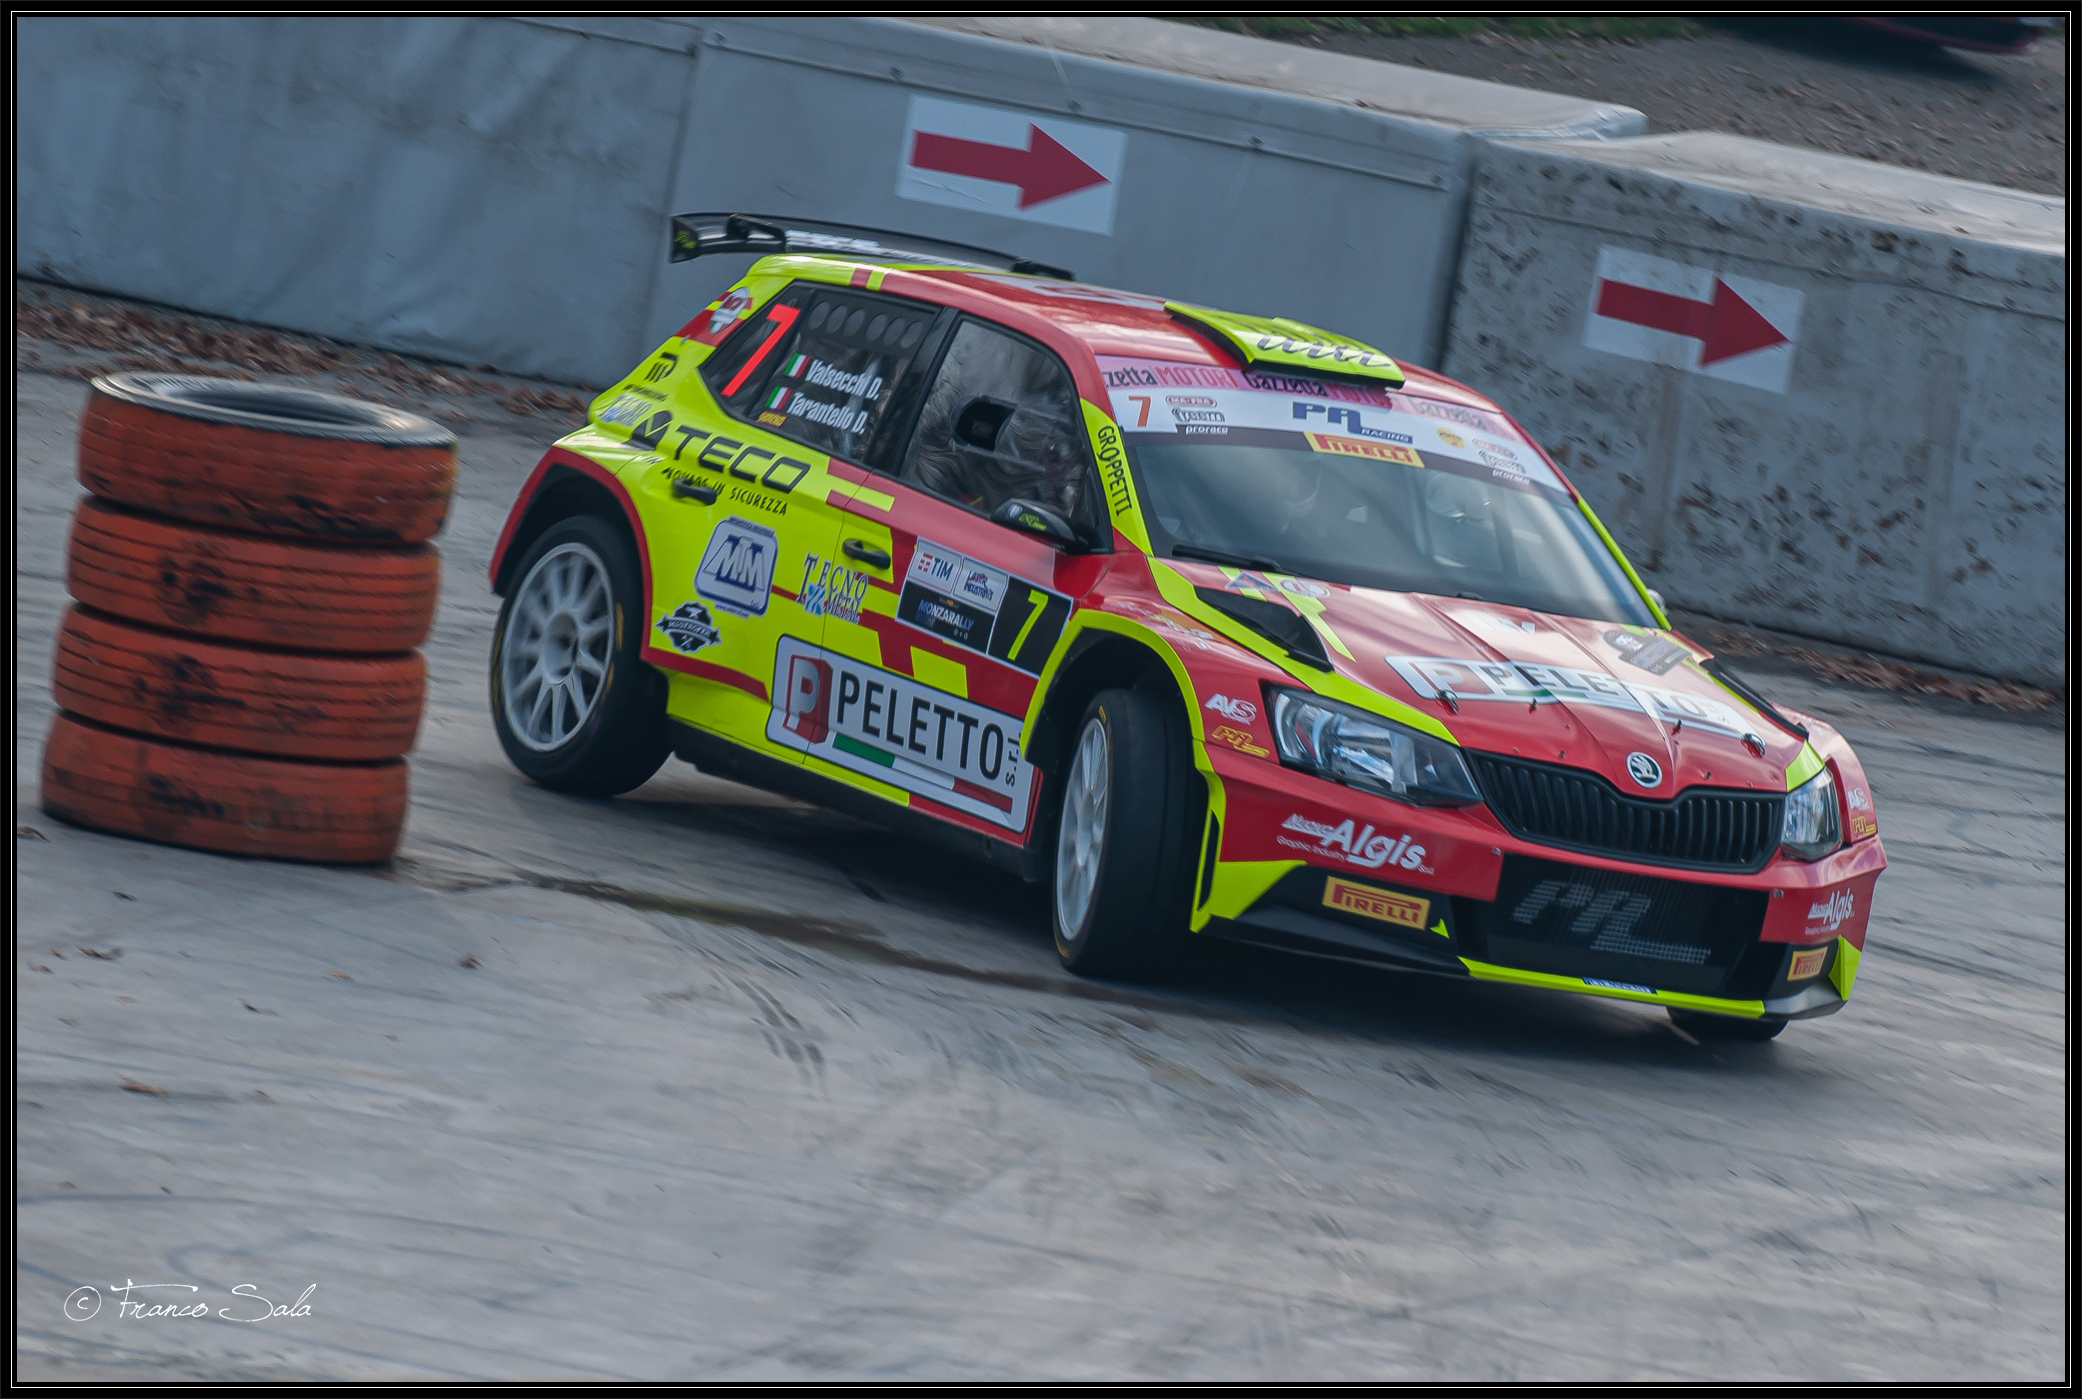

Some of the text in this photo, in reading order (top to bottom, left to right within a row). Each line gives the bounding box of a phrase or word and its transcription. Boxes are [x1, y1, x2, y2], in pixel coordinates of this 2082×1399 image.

[720, 303, 800, 398] 7
[804, 359, 883, 401] Valsecchi D.
[1154, 366, 1239, 388] MOTORI
[786, 391, 855, 431] Tarantello
[850, 410, 869, 435] D.
[1128, 395, 1152, 428] 7
[674, 424, 810, 494] TECO
[1313, 434, 1414, 463] PIRELLI
[1097, 425, 1132, 517] GROPPETTI
[729, 486, 788, 516] SICUREZZA
[796, 552, 869, 604] TECNO
[931, 557, 955, 582] TIM
[1007, 589, 1049, 662] 7
[837, 669, 1004, 781] PELETTO
[1319, 818, 1427, 869] Algis
[1332, 883, 1423, 924] PIRELLI
[1823, 887, 1854, 931] Algis
